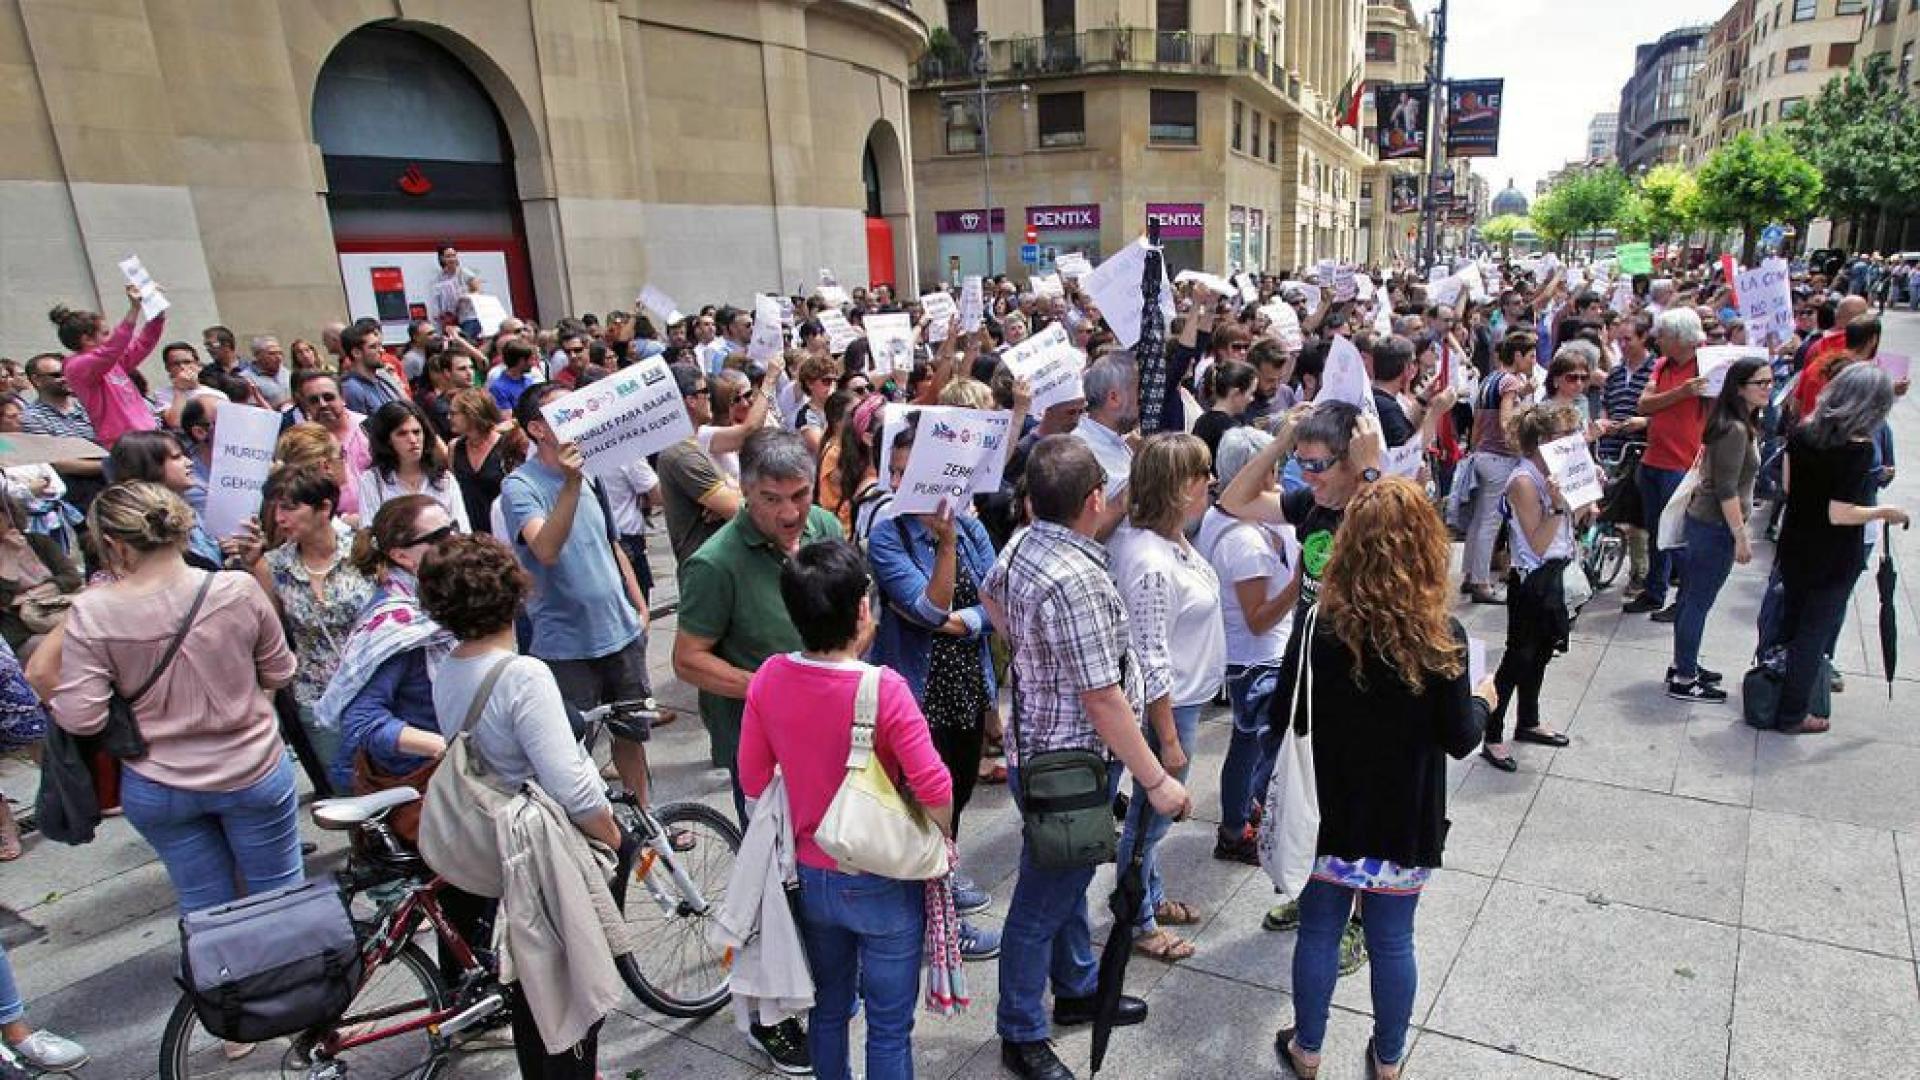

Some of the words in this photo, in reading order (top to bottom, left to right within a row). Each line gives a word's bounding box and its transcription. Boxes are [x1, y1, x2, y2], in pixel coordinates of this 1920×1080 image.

[1033, 211, 1093, 226] DENTIX
[614, 407, 643, 427] PARA
[618, 425, 649, 443] PARA
